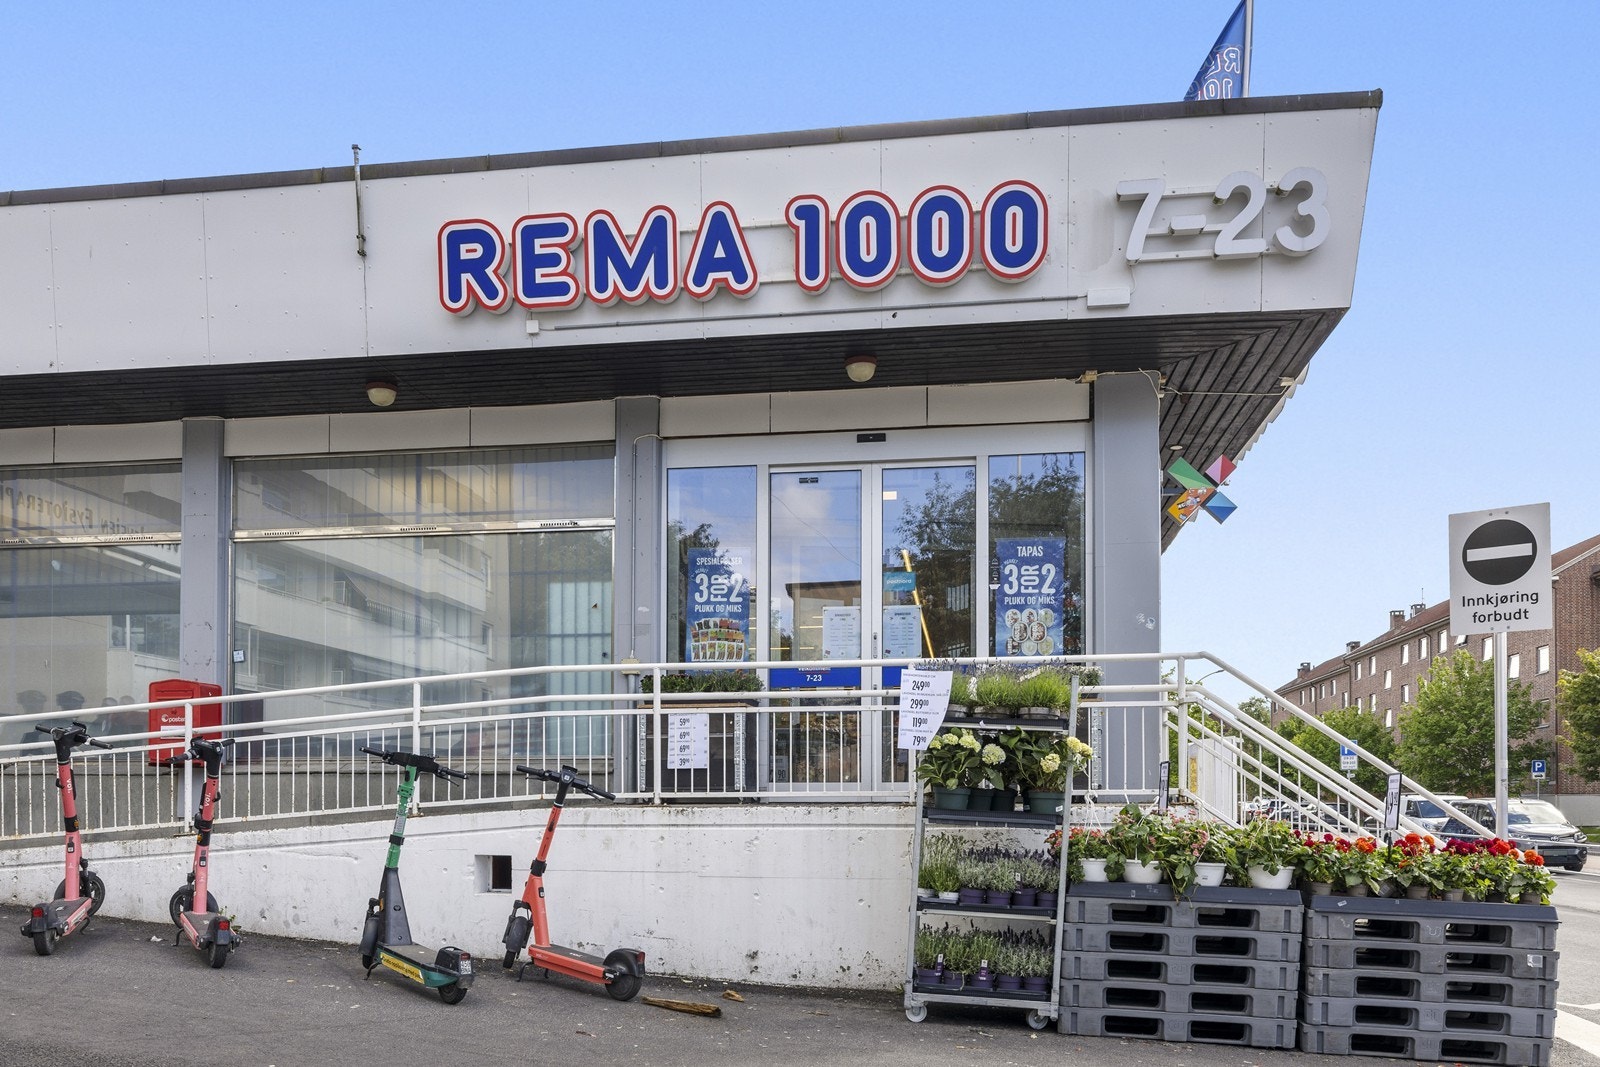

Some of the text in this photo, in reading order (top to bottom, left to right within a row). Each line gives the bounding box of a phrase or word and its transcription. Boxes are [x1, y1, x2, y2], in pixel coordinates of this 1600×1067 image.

[1116, 166, 1331, 266] 7-23
[438, 180, 1048, 314] REMA 1000
[1016, 545, 1044, 557] TAPAS
[1003, 563, 1056, 595] 3 FOR 2
[694, 572, 743, 603] 3 FOR 2
[1004, 596, 1055, 605] PLUKK OG MIKS
[1462, 591, 1539, 608] Innkjøring
[694, 604, 742, 613] PLUKK OG MIKS
[1472, 608, 1529, 624] forbudt
[806, 674, 822, 682] 7-23
[1535, 761, 1543, 772] P
